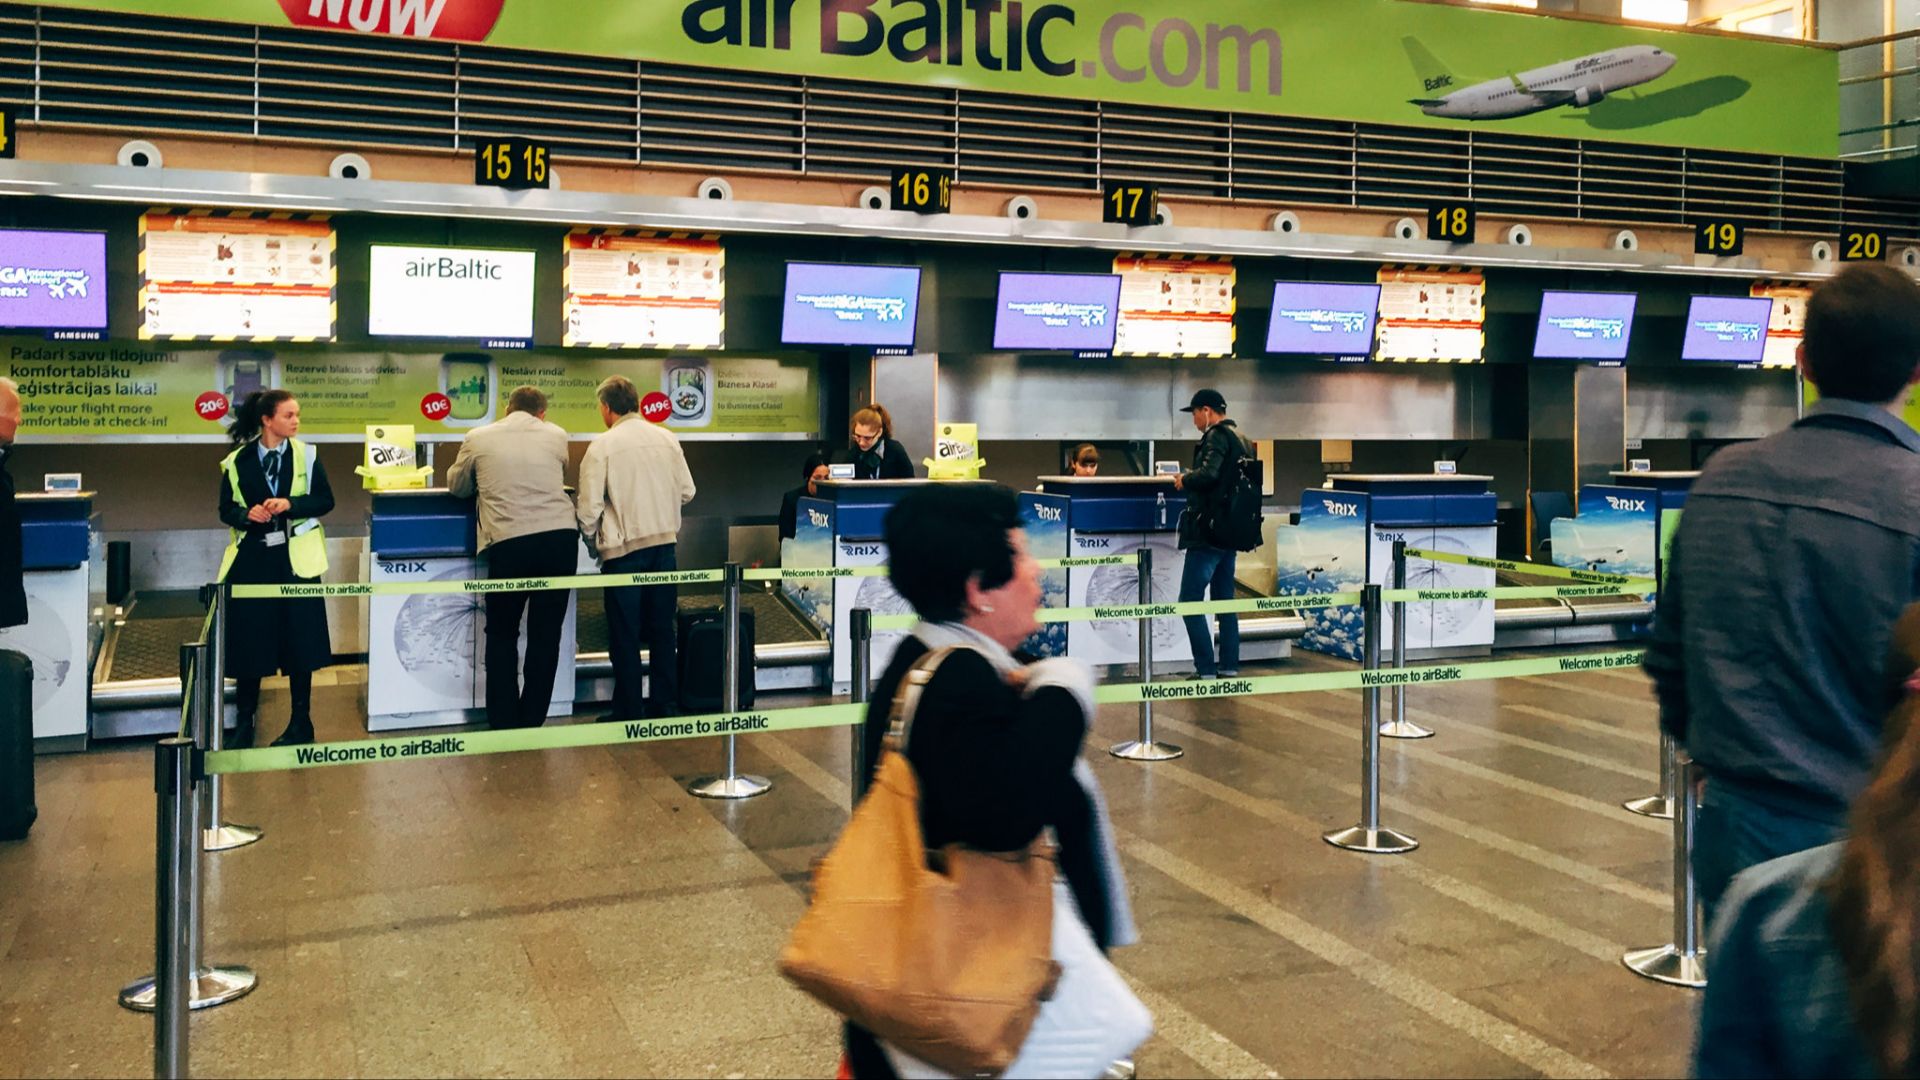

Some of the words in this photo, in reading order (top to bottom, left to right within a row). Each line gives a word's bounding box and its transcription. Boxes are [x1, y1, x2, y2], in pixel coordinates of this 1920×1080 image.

[682, 0, 1282, 96] airBaltic.com
[1424, 75, 1453, 91] Baltic
[482, 144, 511, 180] 15
[523, 145, 546, 182] 15
[898, 172, 929, 206] 16
[939, 175, 949, 208] 16
[1111, 188, 1143, 218] 17
[1436, 207, 1467, 236] 18
[1703, 224, 1736, 249] 19
[1847, 233, 1880, 258] 20
[27, 268, 84, 279] International
[405, 257, 502, 280] airBaltic
[54, 331, 100, 340] SAMSUNG
[488, 340, 526, 348] SAMSUNG
[11, 347, 64, 361] Padari
[68, 351, 105, 362] savu
[110, 349, 179, 365] lidojumu
[10, 364, 131, 379] komfortablāku
[17, 379, 111, 397] eģistrācijas
[115, 381, 158, 396] laikā!
[718, 380, 751, 389] Biznesa
[351, 391, 369, 399] seat
[22, 403, 46, 414] ake
[48, 404, 78, 417] your
[81, 402, 116, 417] flight
[118, 404, 153, 414] more
[199, 398, 226, 414] 20€
[425, 399, 449, 414] 10€
[643, 400, 670, 415] 149€
[18, 416, 90, 428] omfortable
[93, 417, 106, 427] at
[109, 415, 168, 428] check-in!
[395, 561, 427, 573] RIX
[1060, 558, 1089, 567] Welcome
[1091, 557, 1097, 565] to
[1098, 556, 1123, 565] airBaltic
[632, 573, 669, 583] Welcome
[670, 573, 679, 582] to
[680, 571, 710, 581] airBaltic
[781, 569, 816, 577] Welcome
[816, 568, 824, 577] to
[826, 568, 854, 577] airBaltic
[1570, 570, 1597, 581] Welcome
[1598, 574, 1605, 582] to
[280, 585, 324, 595] Welcome
[325, 585, 335, 594] to
[337, 584, 373, 594] airBaltic
[464, 581, 504, 591] Welcome
[505, 581, 514, 590] to
[515, 579, 549, 589] airBaltic
[1556, 586, 1587, 596] Welcome
[1588, 586, 1595, 594] to
[1596, 585, 1621, 595] airBaltic
[1418, 590, 1450, 600] Welcome
[1452, 590, 1460, 599] to
[1461, 589, 1488, 599] airBaltic
[1256, 599, 1293, 609] Welcome
[1293, 598, 1302, 607] to
[1302, 596, 1332, 606] airBaltic
[1094, 608, 1133, 618] Welcome
[1134, 607, 1143, 616] to
[1144, 605, 1177, 615] airBaltic
[1559, 657, 1602, 670] Welcome
[1604, 655, 1613, 667] to
[1361, 671, 1408, 685] Welcome
[1410, 669, 1420, 682] to
[1422, 666, 1462, 680] airBaltic
[1141, 684, 1194, 699] Welcome
[1195, 683, 1207, 696] to
[1209, 680, 1252, 694] airBaltic
[625, 721, 693, 739] Welcome
[695, 719, 710, 733] to
[713, 715, 769, 732] airBaltic
[296, 746, 376, 764] Welcome
[380, 743, 397, 758] to
[400, 737, 465, 756] airBaltic
